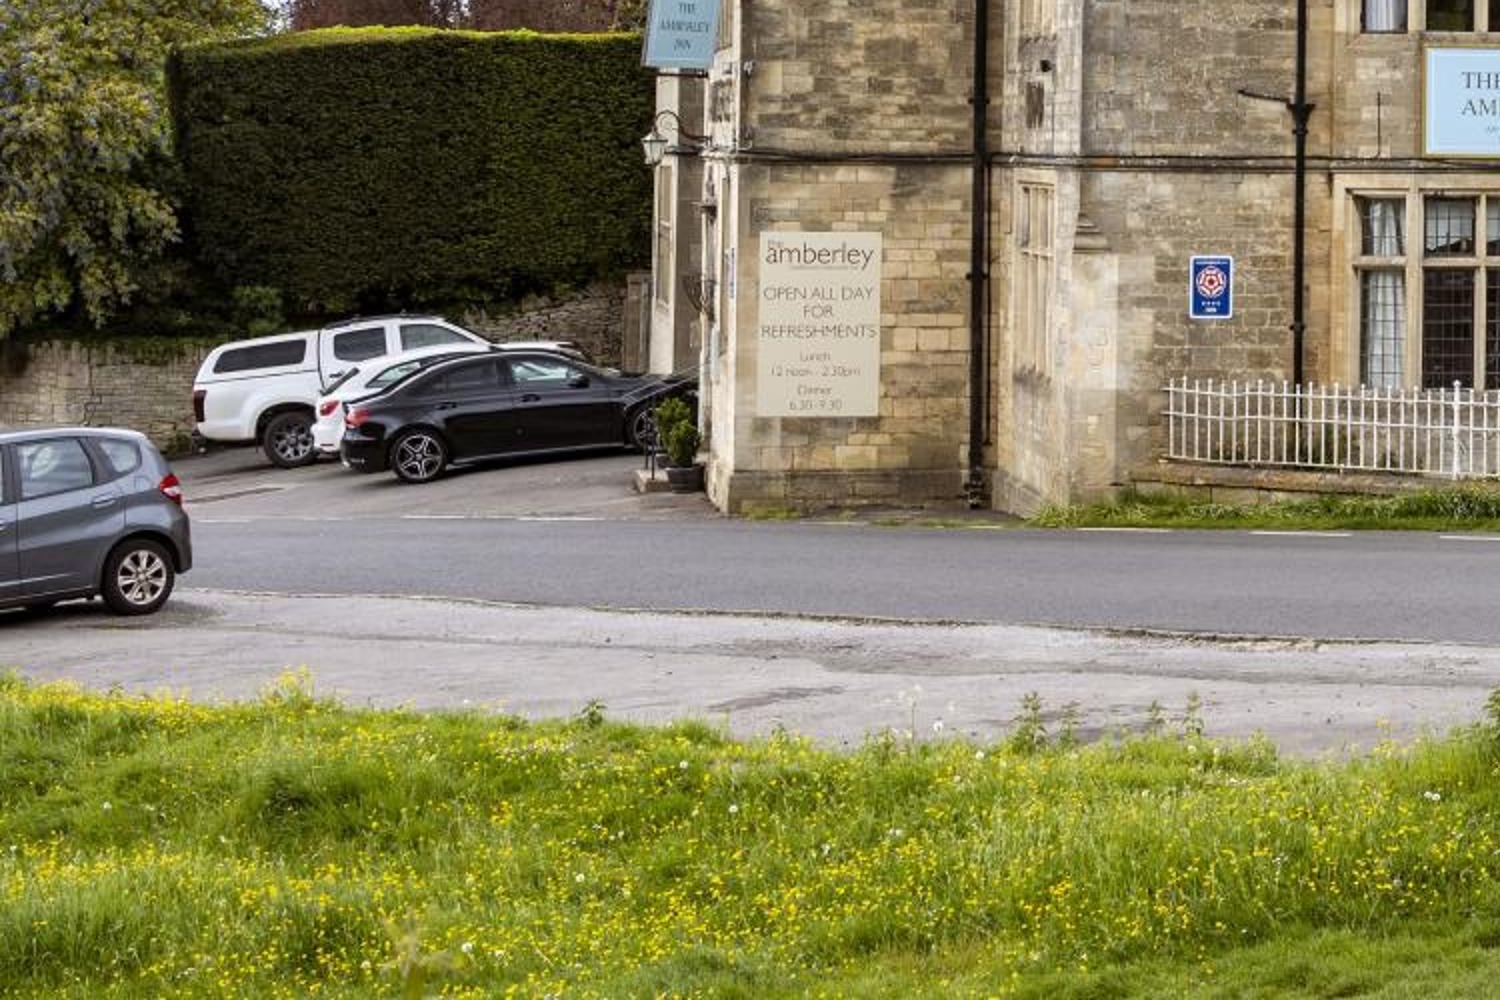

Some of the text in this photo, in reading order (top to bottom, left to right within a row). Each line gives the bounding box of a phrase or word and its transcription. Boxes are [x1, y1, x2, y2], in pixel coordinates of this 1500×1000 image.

[765, 242, 874, 270] amberley
[763, 287, 873, 301] OPEN ALL DAY
[803, 304, 834, 319] FOR
[761, 324, 878, 339] REFRESHMENTS
[800, 351, 832, 361] Lunch
